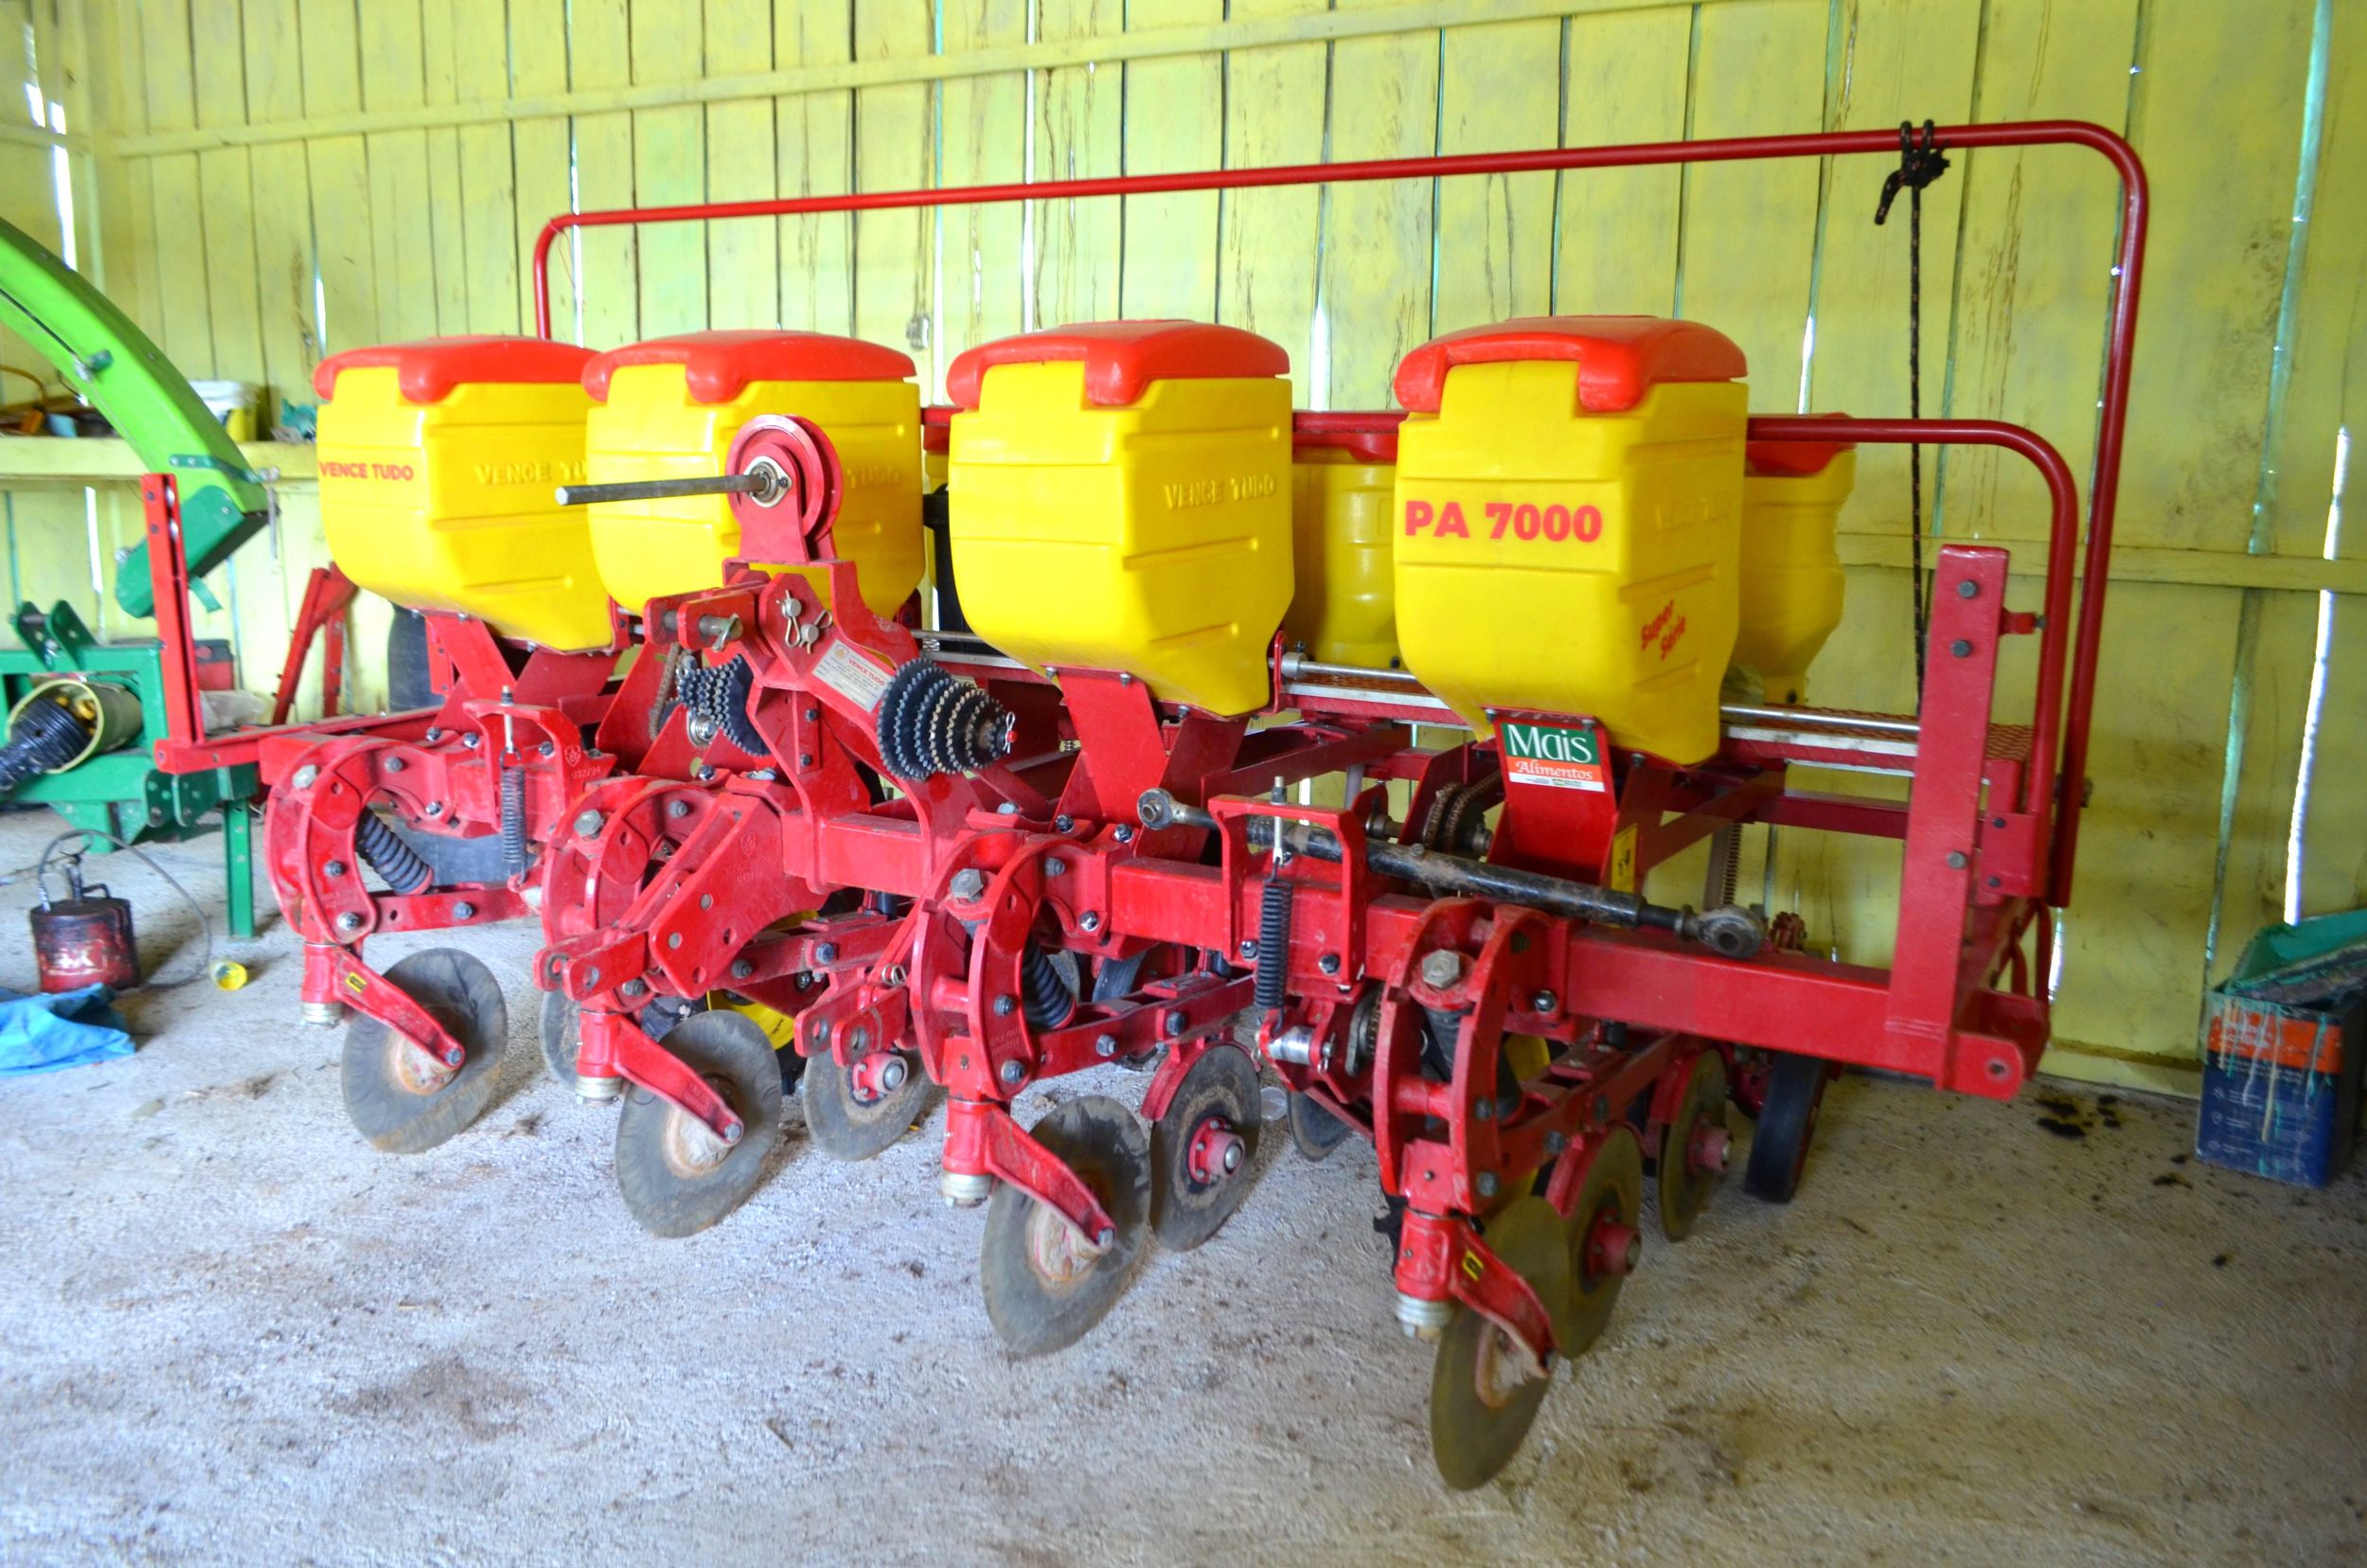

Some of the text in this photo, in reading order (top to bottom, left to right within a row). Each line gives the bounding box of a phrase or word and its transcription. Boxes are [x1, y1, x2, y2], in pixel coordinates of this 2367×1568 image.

[318, 461, 414, 481] VENCE TUDO
[474, 460, 586, 486] VENCE TU
[1165, 473, 1276, 508] VENCE TUDO
[1404, 500, 1603, 543] PA 7000
[1507, 723, 1593, 764] Mais
[1515, 759, 1593, 781] Alimentos
